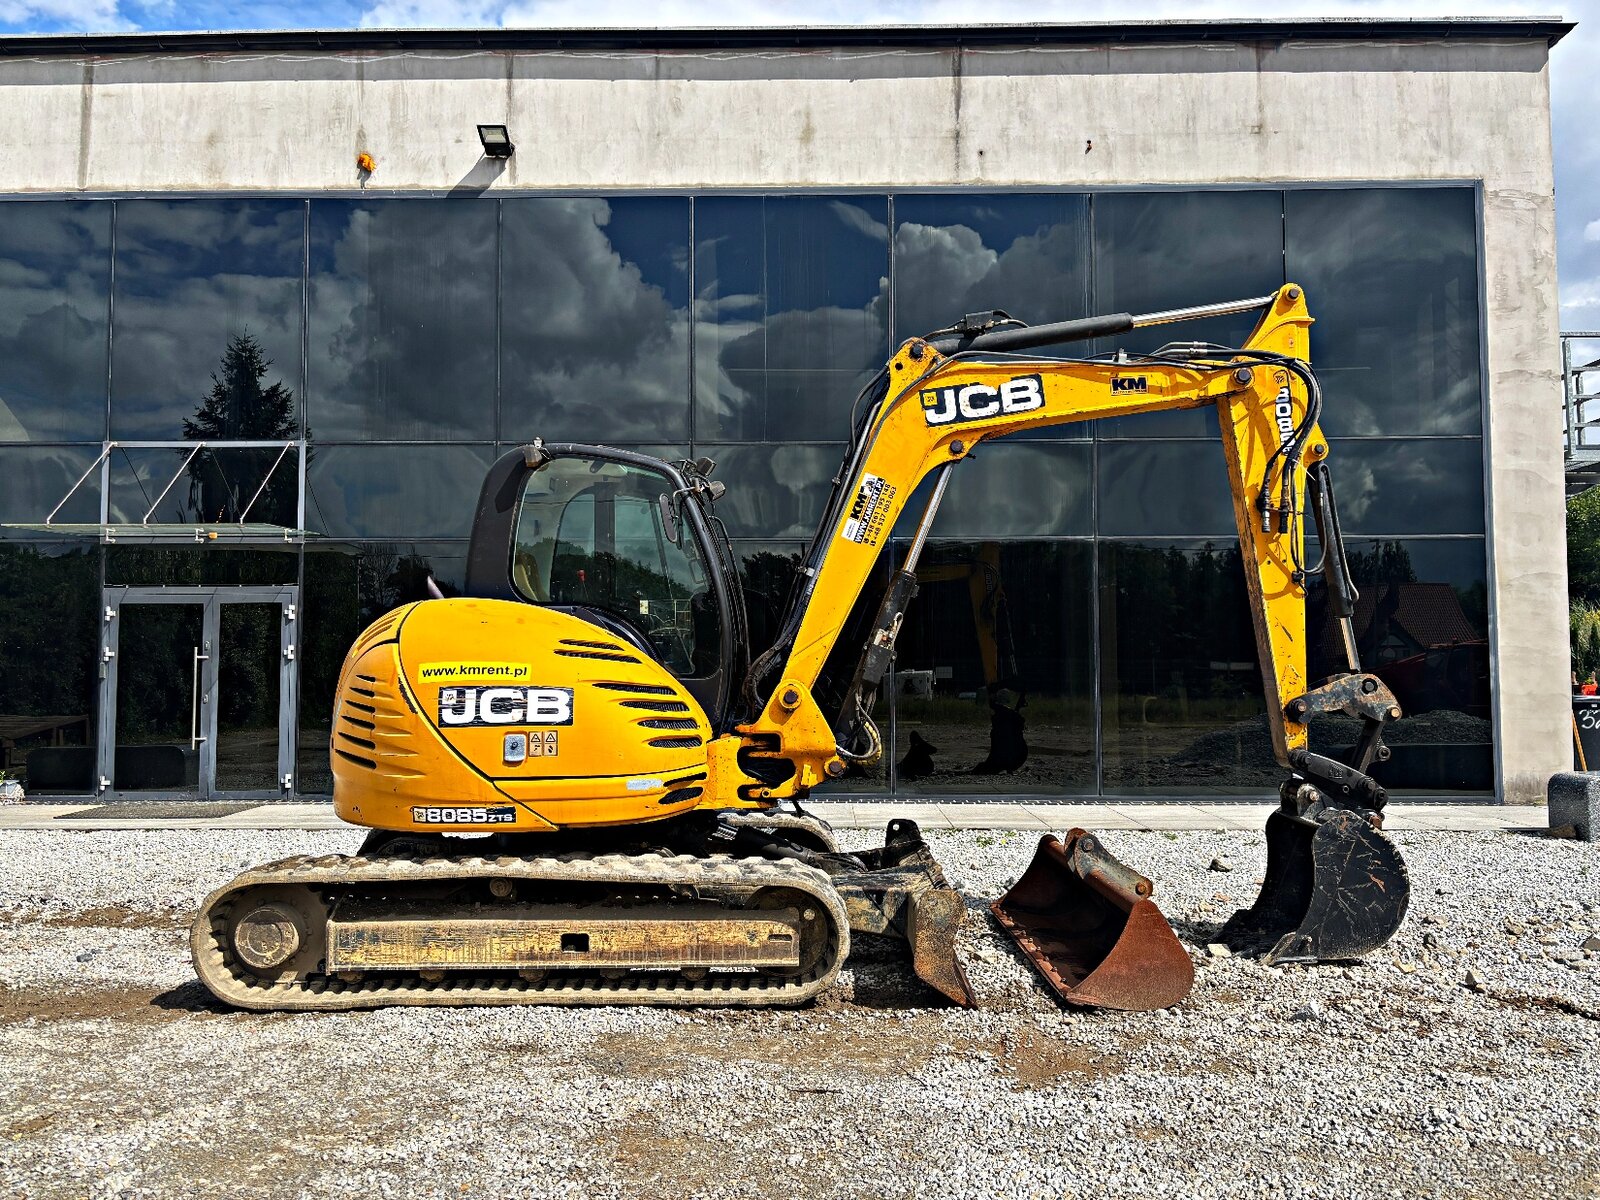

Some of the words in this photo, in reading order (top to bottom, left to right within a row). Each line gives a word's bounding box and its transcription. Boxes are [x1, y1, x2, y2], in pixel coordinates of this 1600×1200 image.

[1112, 377, 1147, 391] KM
[925, 378, 1042, 424] JCB
[850, 493, 868, 520] KM
[855, 479, 885, 543] WWW.KMRENT.PL
[422, 664, 527, 678] www.kmrent.pl
[441, 688, 571, 724] JCB
[426, 808, 488, 823] 8085
[488, 813, 513, 822] ZTS
